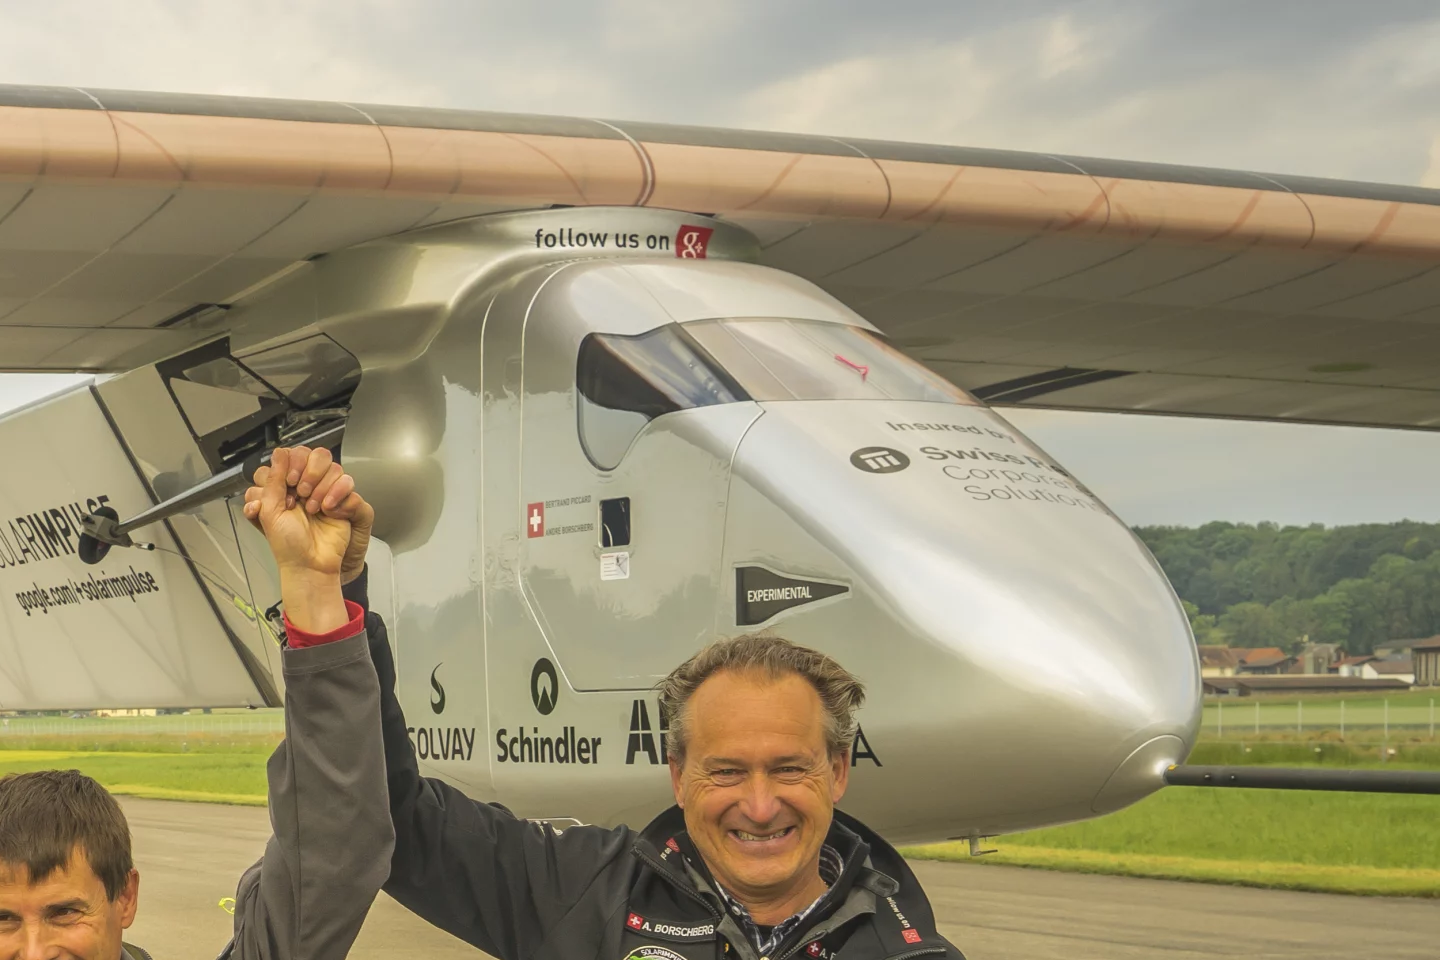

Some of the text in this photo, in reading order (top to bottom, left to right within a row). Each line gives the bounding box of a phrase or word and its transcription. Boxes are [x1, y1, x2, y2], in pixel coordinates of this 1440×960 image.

[535, 228, 607, 248] follow
[615, 232, 639, 248] us
[646, 233, 669, 250] on
[885, 421, 984, 435] Insured
[919, 446, 1025, 465] Swiss
[15, 565, 159, 616] google.com/+solarimpulse
[747, 586, 812, 603] EXPERIMENTAL
[496, 726, 601, 764] Schindler
[641, 922, 714, 937] A. BORSCHBERG
